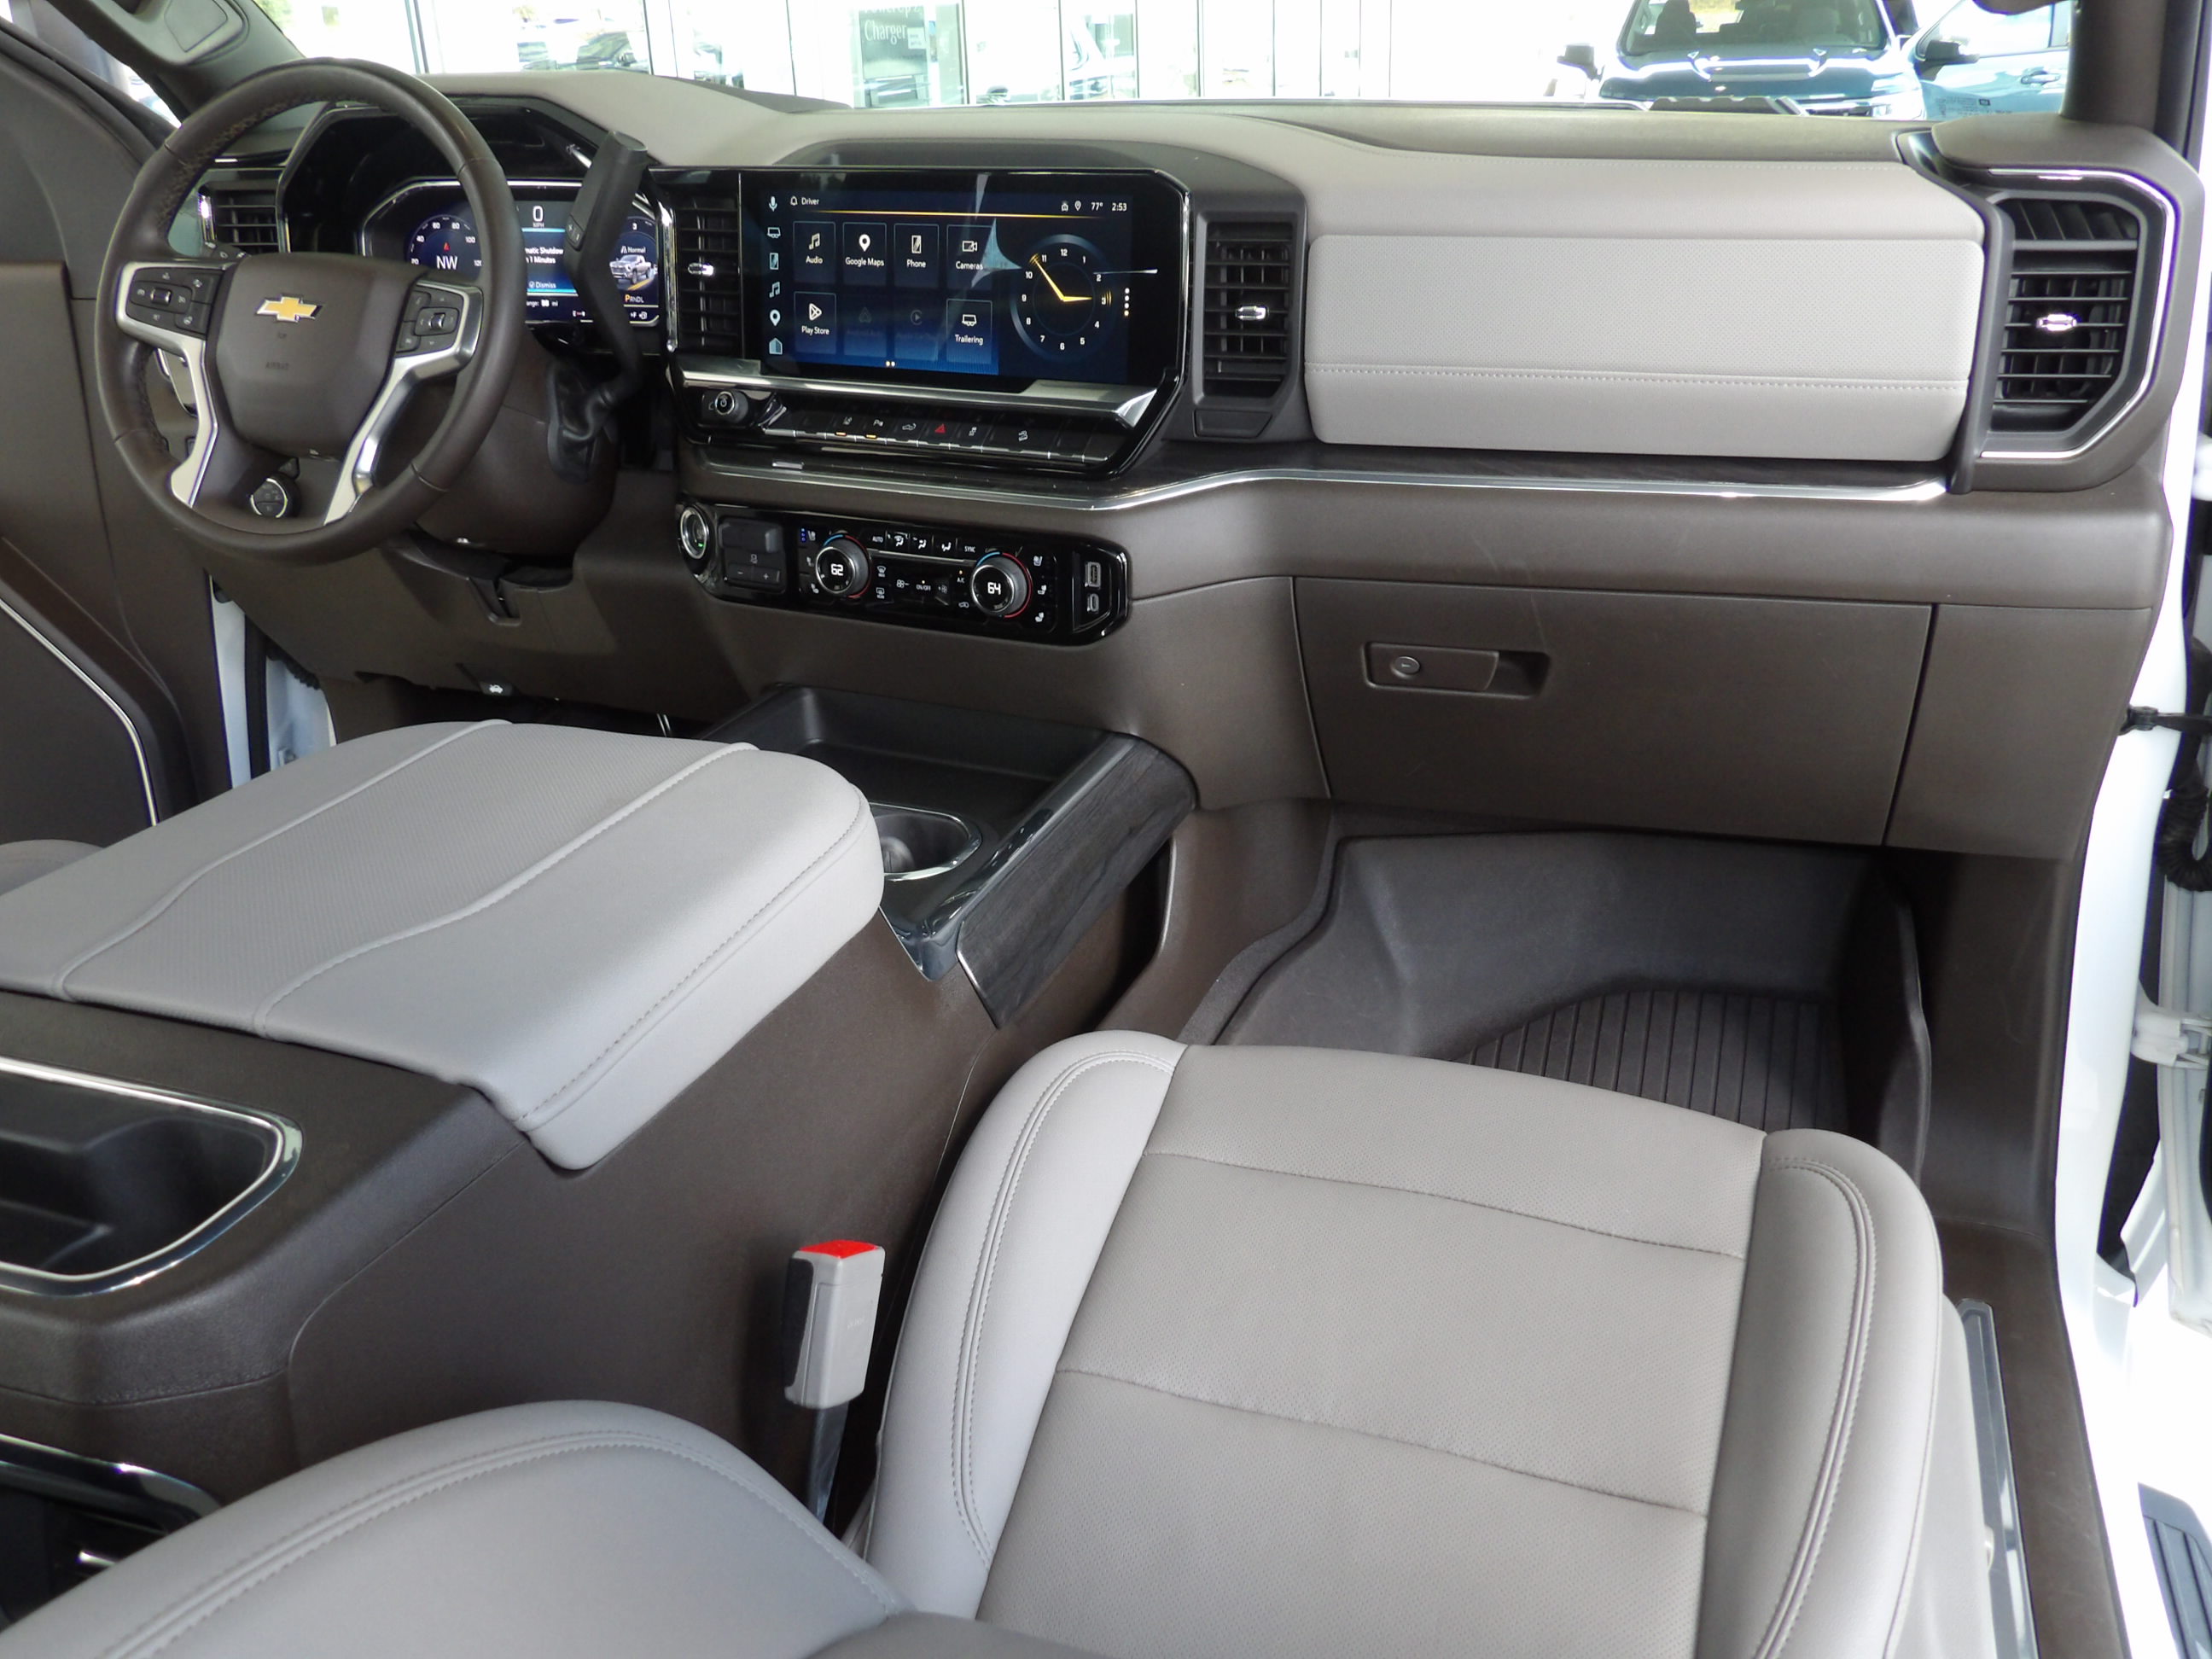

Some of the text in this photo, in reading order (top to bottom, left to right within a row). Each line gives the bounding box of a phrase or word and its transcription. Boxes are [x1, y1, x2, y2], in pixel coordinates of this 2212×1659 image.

[864, 20, 906, 44] Charger
[1111, 202, 1127, 212] 2:53
[533, 205, 544, 222] 0
[436, 255, 457, 270] NW
[845, 257, 885, 267] Google Maps
[906, 259, 926, 268] Phone
[955, 261, 983, 271] Cameras
[801, 325, 830, 336] Play Store
[955, 334, 983, 346] Trailering
[830, 563, 844, 576] 62
[987, 582, 1001, 595] 64
